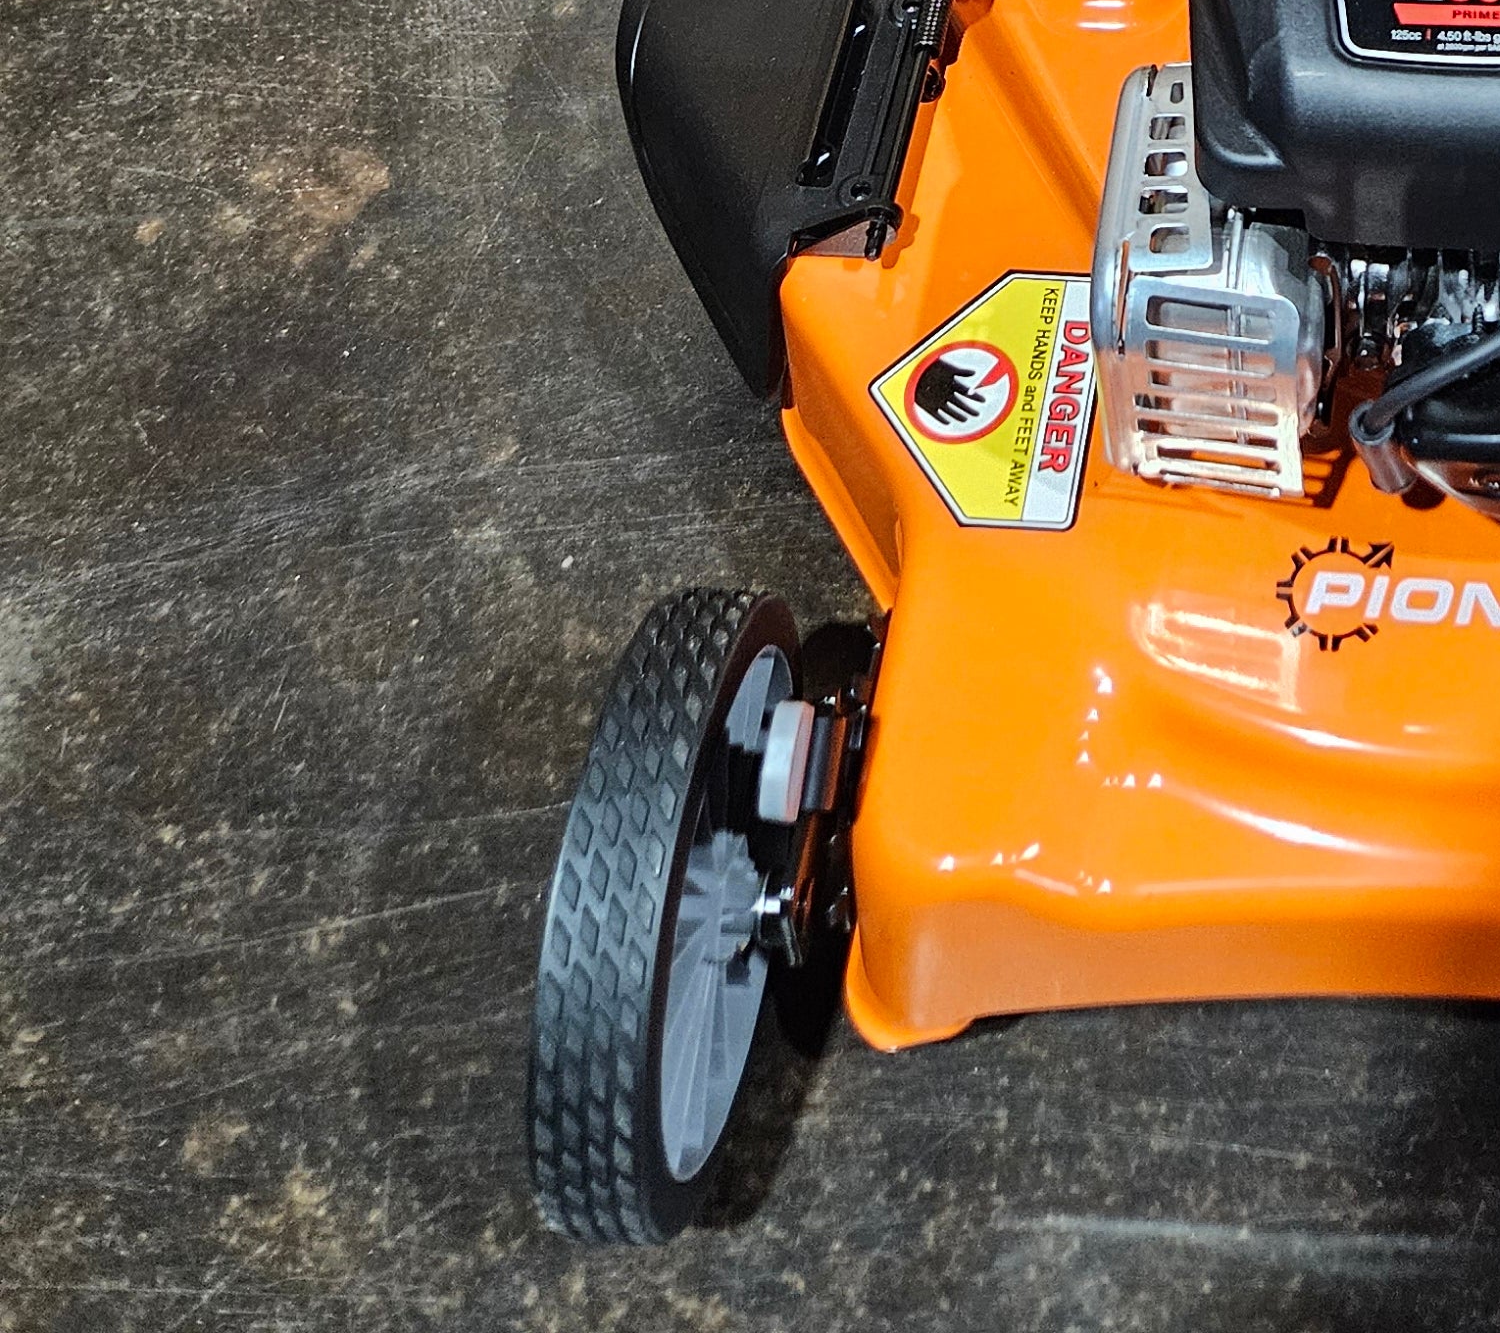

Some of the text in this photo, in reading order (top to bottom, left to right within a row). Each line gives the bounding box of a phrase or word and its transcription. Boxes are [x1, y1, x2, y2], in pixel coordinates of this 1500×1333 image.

[1390, 29, 1422, 42] 125cc
[1436, 30, 1462, 42] 4.50
[1452, 9, 1500, 21] PRIME
[1003, 287, 1060, 507] KEEP HANDS and FEET AWAY
[1038, 320, 1091, 473] DANGER
